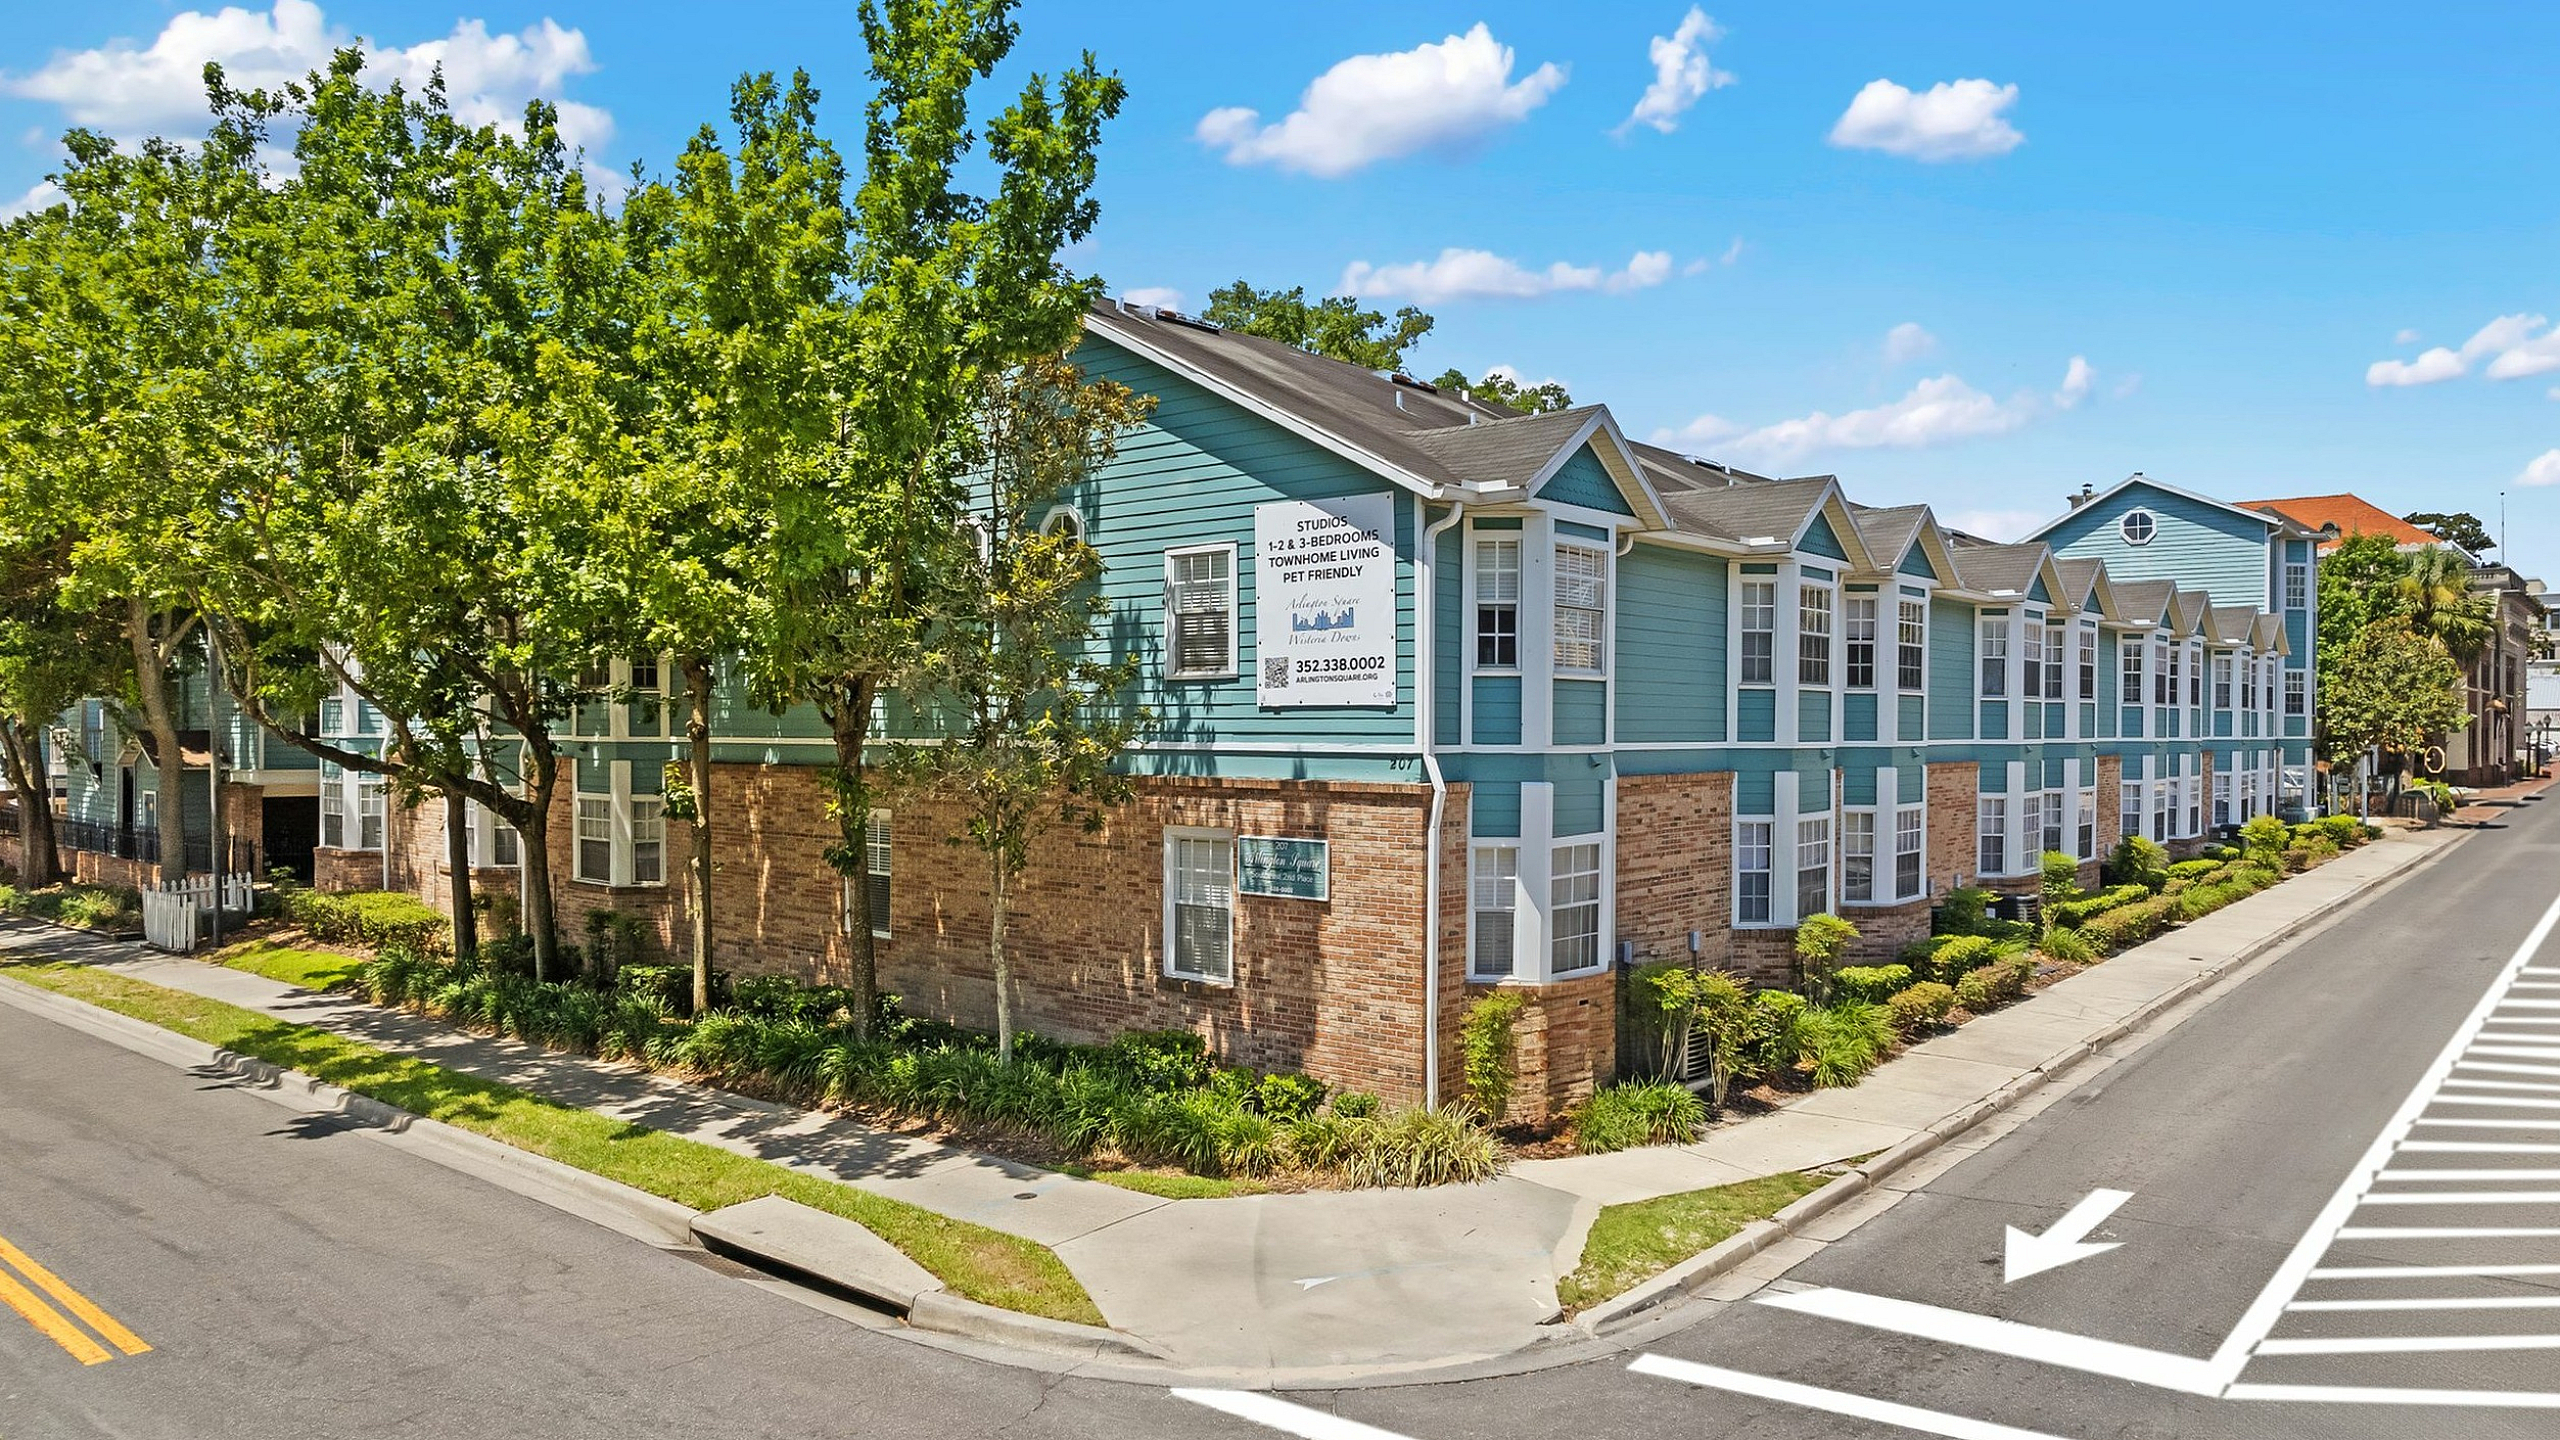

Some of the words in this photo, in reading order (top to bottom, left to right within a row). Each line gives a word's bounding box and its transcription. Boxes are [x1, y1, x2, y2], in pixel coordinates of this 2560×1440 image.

[1297, 515, 1348, 532] STUDIOS
[1268, 540, 1285, 552] 1-2
[1287, 539, 1295, 550] &
[1299, 529, 1379, 549] 3-BEDROOMS
[1268, 551, 1337, 568] TOWNHOME
[1340, 547, 1380, 561] LIVING
[1283, 571, 1305, 583] PET
[1308, 565, 1363, 581] FRIENDLY
[1285, 593, 1328, 617] Arlington
[1331, 595, 1361, 616] Square
[1296, 656, 1386, 673] 352.338.0002
[1296, 673, 1378, 684] ARLINGTONSQUARE.ORG
[1390, 756, 1414, 770] 207
[1275, 842, 1289, 850] 207
[1245, 850, 1286, 871] Arlington
[1289, 852, 1321, 873] Square
